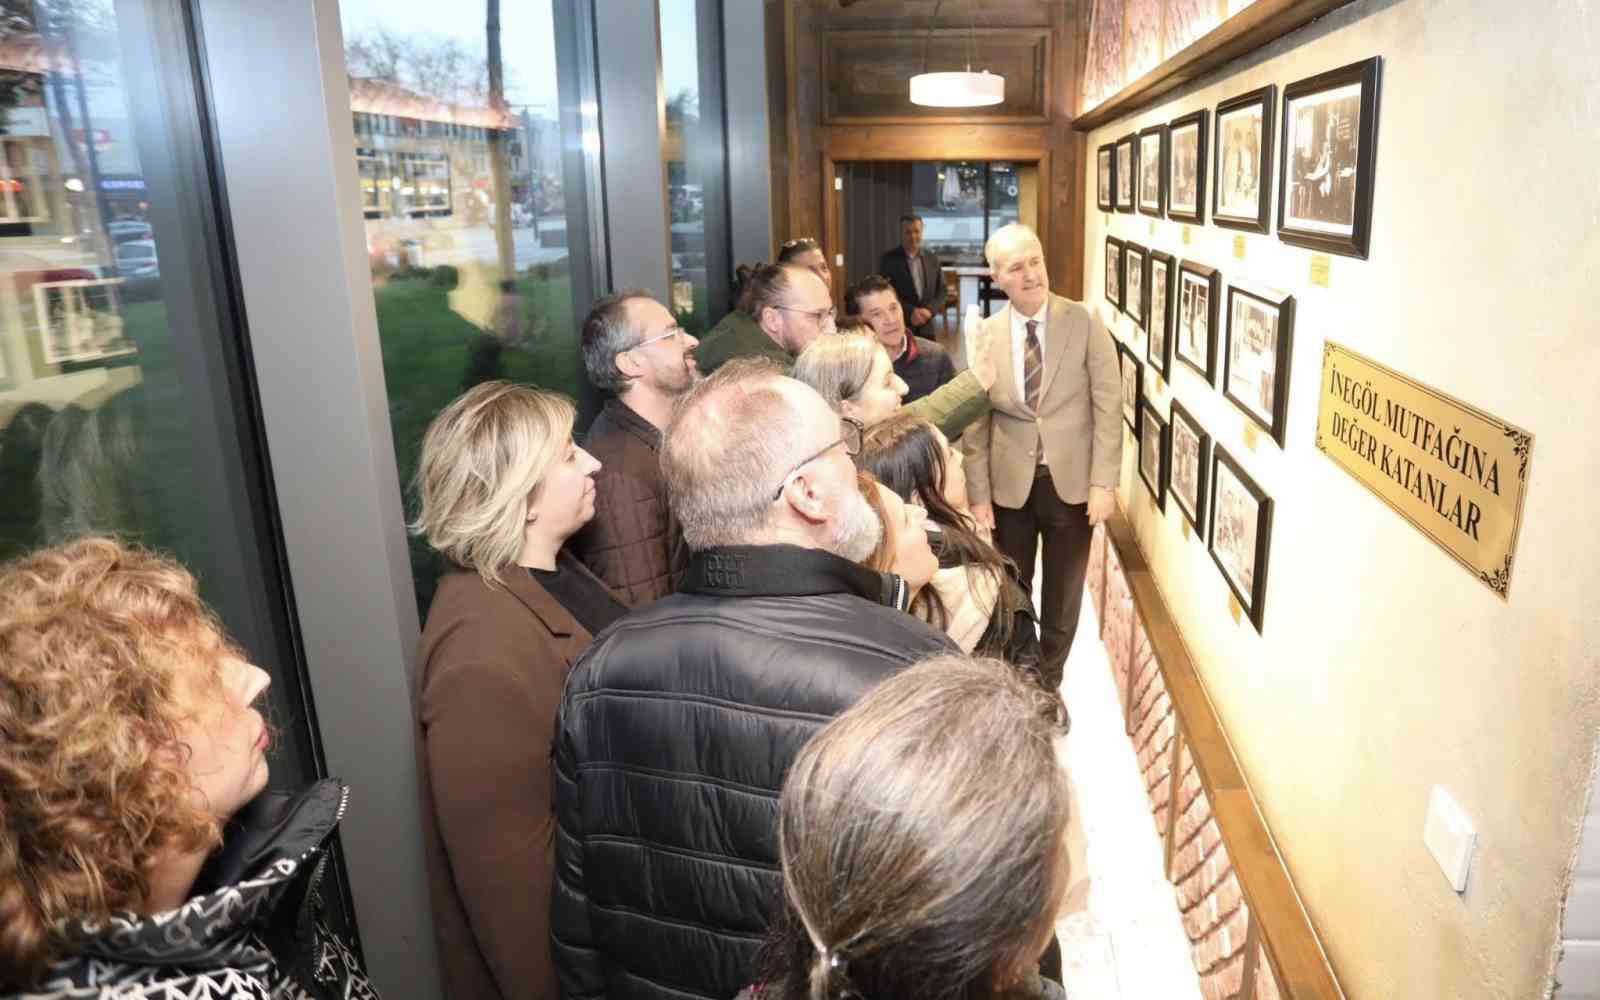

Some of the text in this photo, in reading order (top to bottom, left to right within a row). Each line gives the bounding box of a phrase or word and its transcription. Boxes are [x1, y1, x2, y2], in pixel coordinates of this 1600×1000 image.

[1330, 364, 1500, 496] İNEGÖL MUTFAĞINA
[1331, 411, 1481, 541] DEĞER KATANLAR
